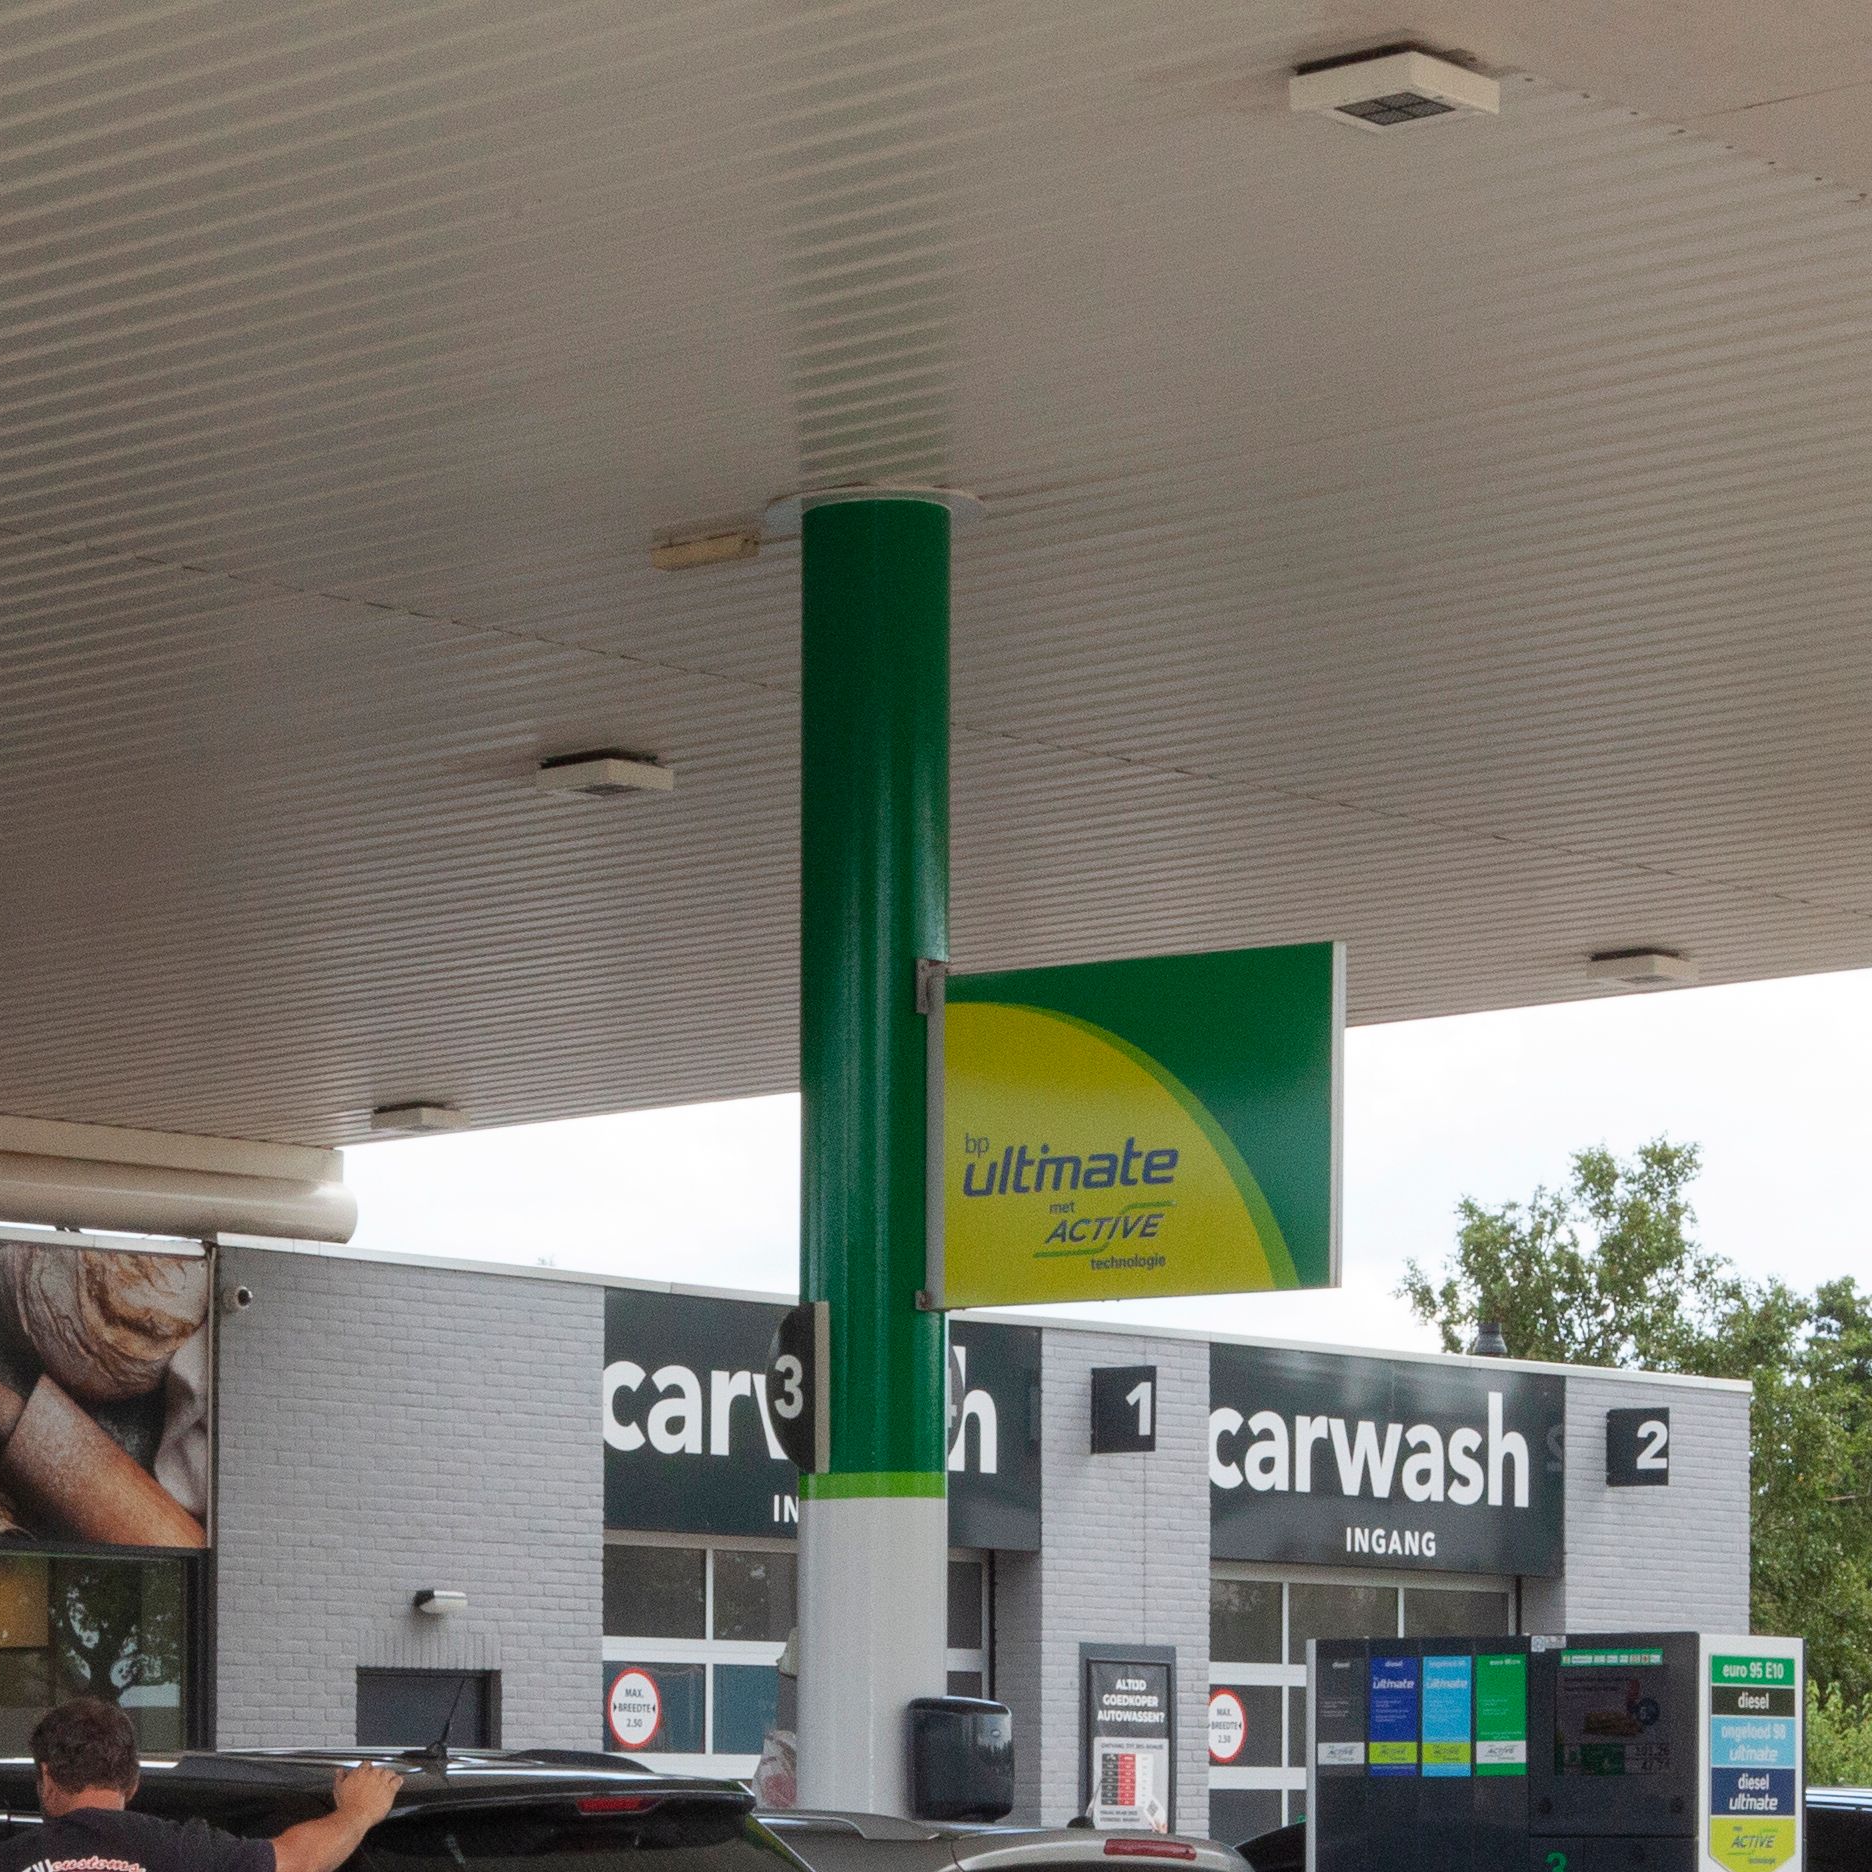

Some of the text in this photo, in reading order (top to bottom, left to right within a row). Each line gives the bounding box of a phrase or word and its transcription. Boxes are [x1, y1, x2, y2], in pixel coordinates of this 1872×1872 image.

[964, 1132, 990, 1156] bp
[963, 1136, 1180, 1199] ultimate
[1049, 1200, 1075, 1216] met
[1044, 1213, 1165, 1245] ACTIVE
[1090, 1252, 1166, 1273] technologie
[774, 1354, 804, 1420] 3
[1125, 1381, 1153, 1437] 1
[1209, 1391, 1530, 1508] carwash
[1636, 1420, 1669, 1471] 2
[1345, 1526, 1437, 1559] INGANG
[1722, 1662, 1784, 1680] euro 95 E10
[625, 1689, 644, 1698] MAX.
[1102, 1693, 1159, 1708] GOEDKOPER
[1738, 1692, 1770, 1710] diesel
[618, 1702, 651, 1713] BREEDTE
[1097, 1709, 1165, 1723] AUTOWASSEN?
[1729, 1747, 1779, 1763] ultimate
[1738, 1772, 1770, 1791] diesel
[1729, 1793, 1778, 1811] ultimate
[1731, 1835, 1775, 1849] ACTIVE
